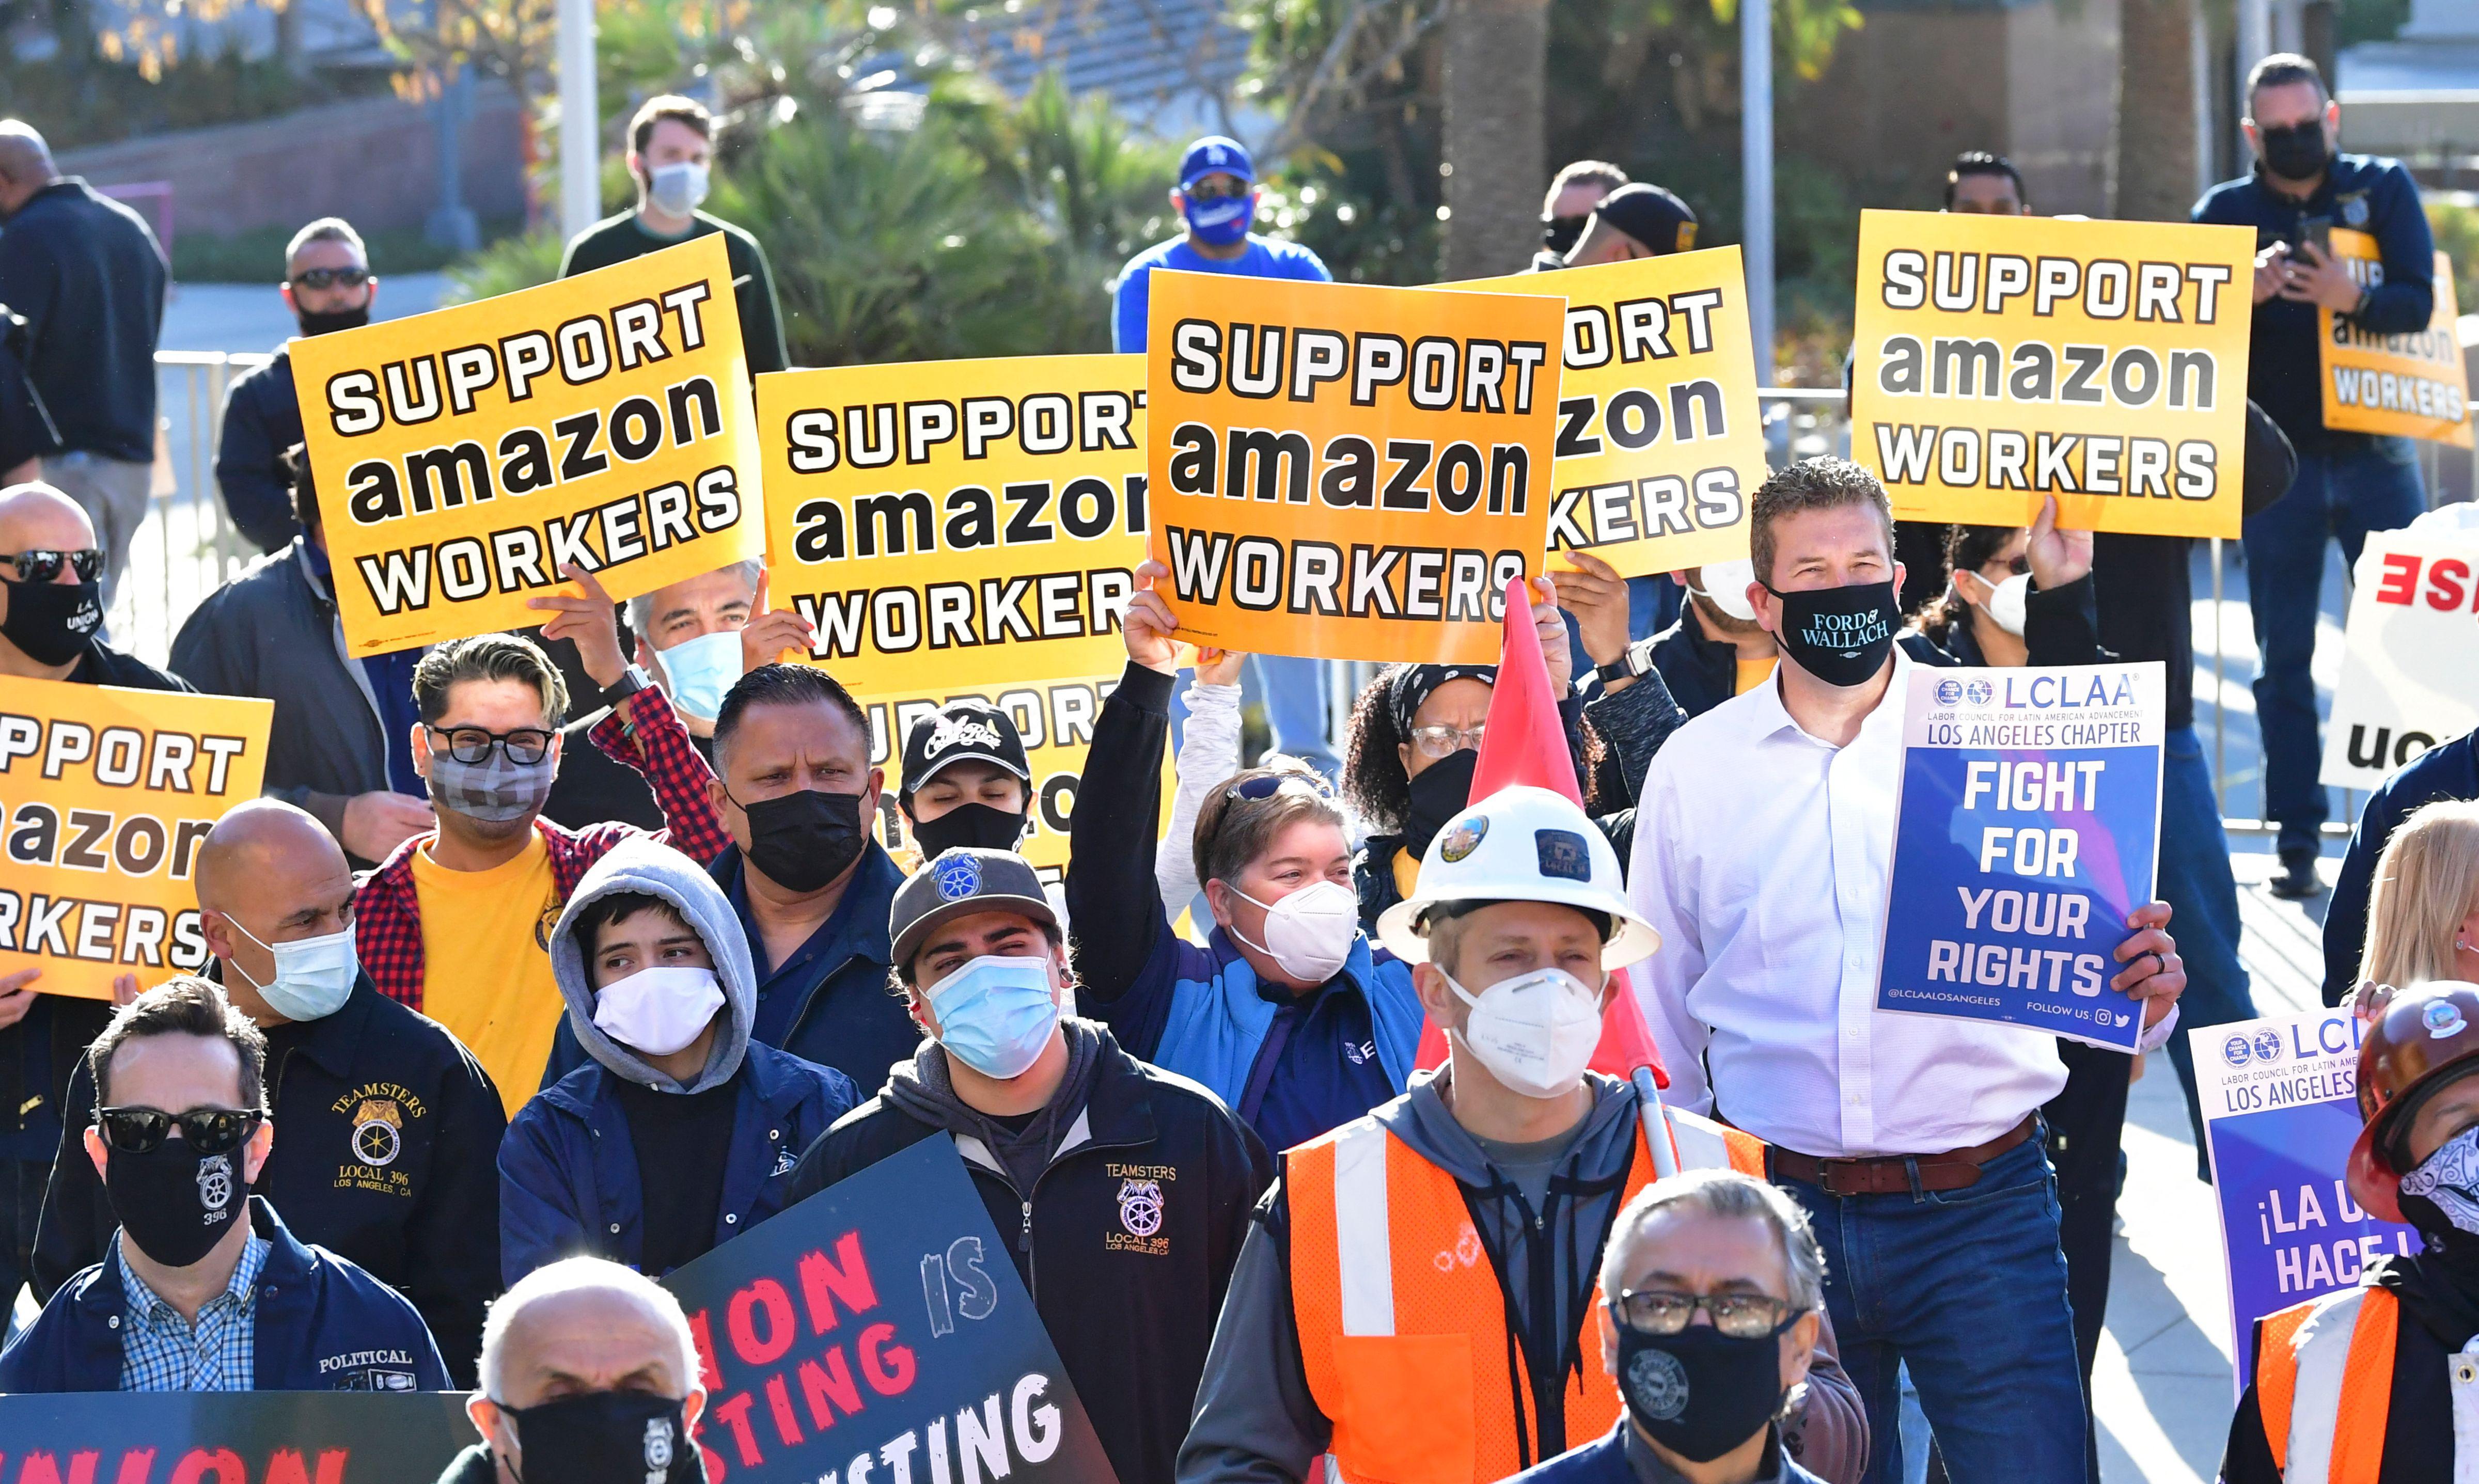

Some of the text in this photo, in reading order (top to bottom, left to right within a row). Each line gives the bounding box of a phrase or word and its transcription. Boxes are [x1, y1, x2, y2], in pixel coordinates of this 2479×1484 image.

[1882, 248, 2232, 325] SUPPORT
[326, 279, 710, 437] SUPPORT
[1171, 318, 1546, 415] SUPPORT
[1877, 334, 2217, 412] amazon
[2332, 364, 2464, 423] WORKERS
[346, 374, 724, 526] amazon
[787, 390, 1147, 474] SUPPOR
[1168, 421, 1531, 516] amazon
[1873, 422, 2217, 500] WORKERS
[355, 465, 742, 615] WORKERS
[1165, 525, 1525, 623] WORKERS
[67, 608, 99, 629] UNION
[1801, 620, 1889, 649] WALLACH
[1927, 709, 2143, 721] LABOR COUNCIL FOR LATIN AMERICAN ADVANCEMENT
[2005, 673, 2137, 709] LCLAA
[0, 712, 246, 796] PPORT
[1927, 722, 2140, 746] LOS ANGELES CHAPTER
[1964, 760, 2105, 811] FIGHT
[0, 800, 218, 880] azon
[1980, 826, 2079, 878] FOR
[0, 889, 210, 969] RKERS
[1957, 886, 2090, 939] YOUR
[1927, 940, 2104, 998] RIGHTS
[1888, 989, 2000, 1006] @LCLAALOSANGELES
[2027, 1002, 2092, 1020] FOLLOW US:
[2221, 1073, 2249, 1085] LABOR
[2253, 1067, 2289, 1081] COUNCIL
[2292, 1064, 2308, 1075] FOR
[2312, 1059, 2336, 1071] LATIN
[2225, 1070, 2355, 1112] LOS ANGELES
[331, 1082, 427, 1118] TEAMSTERS
[334, 1179, 412, 1197] LOS ANGELES, CA
[339, 1165, 409, 1186] LOCAL 396
[1105, 1163, 1176, 1181] TEAMSTERS
[203, 1208, 228, 1225] 396
[2258, 1179, 2376, 1245] ¡LA U
[1106, 1232, 1169, 1249] LOCAL 396
[1123, 1244, 1158, 1255] ANGELES
[920, 1236, 998, 1338] IS
[319, 1349, 413, 1374] POLITICAL
